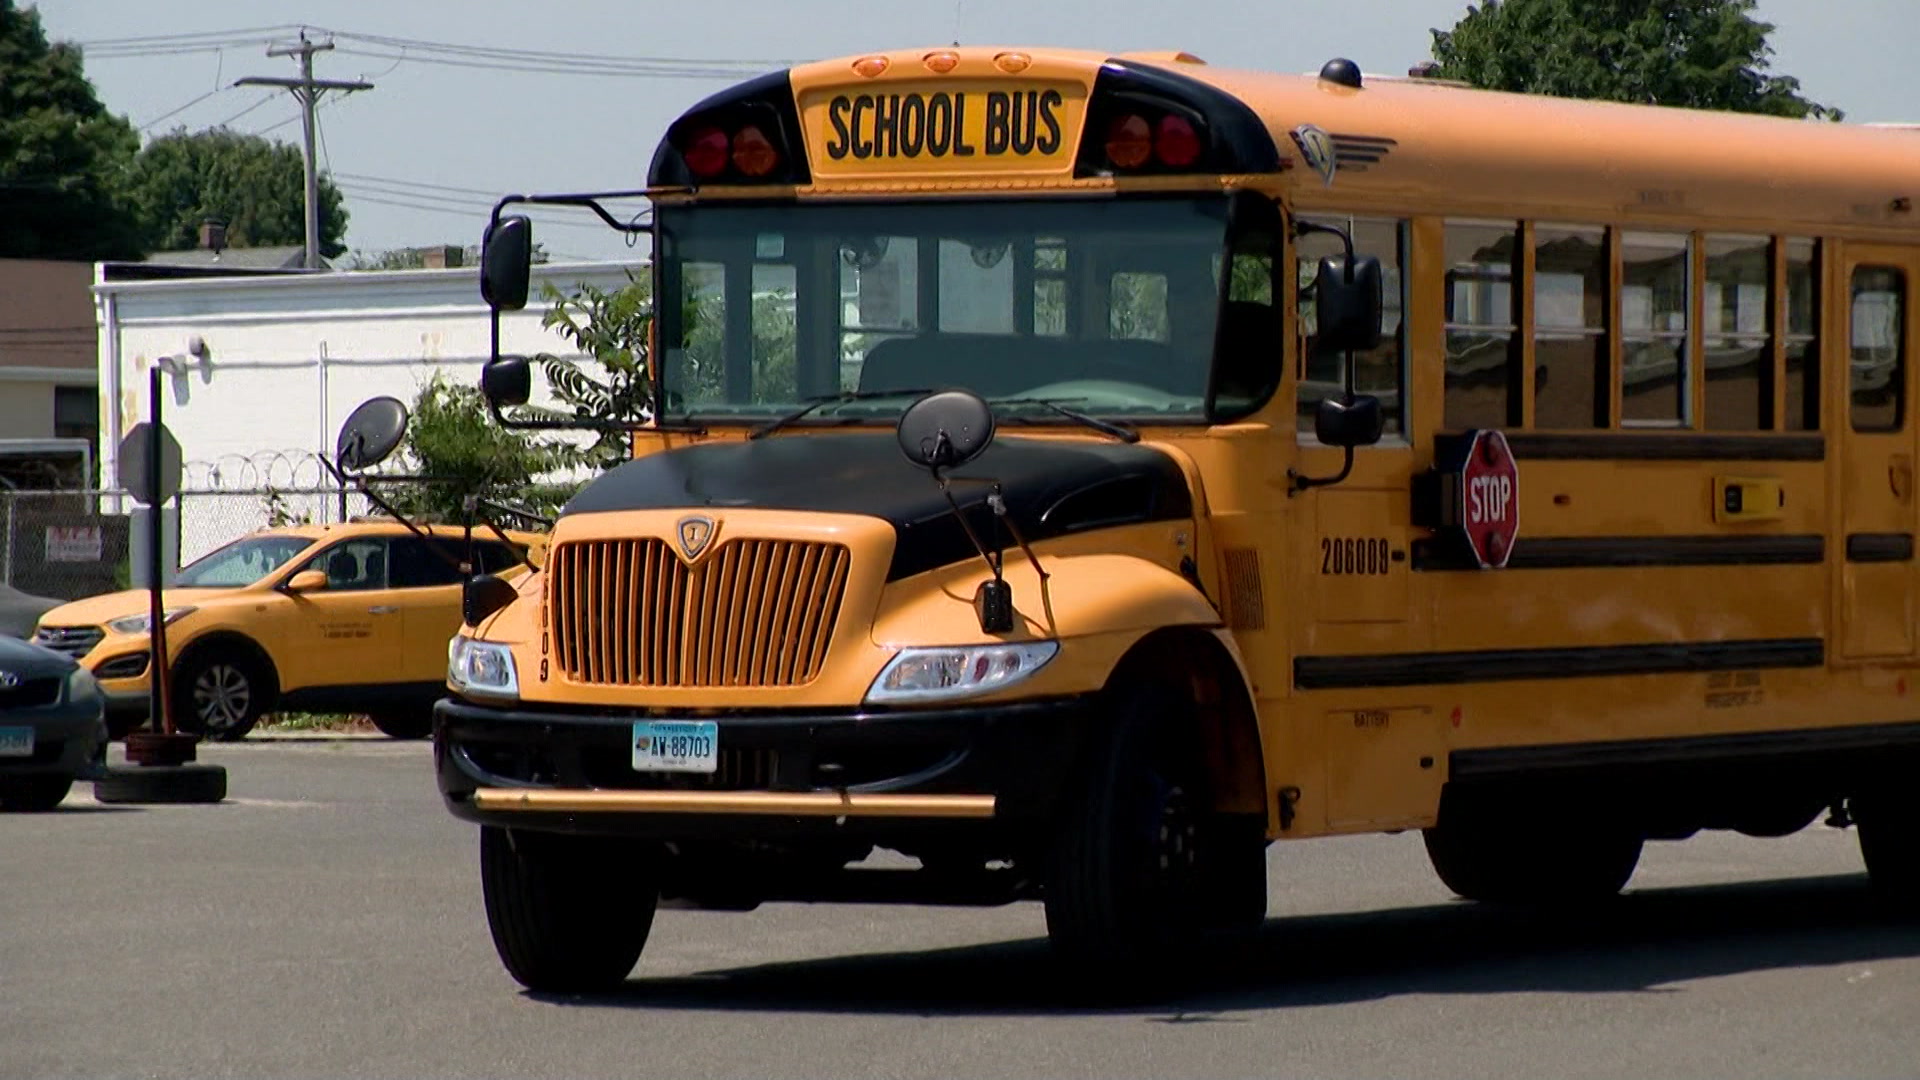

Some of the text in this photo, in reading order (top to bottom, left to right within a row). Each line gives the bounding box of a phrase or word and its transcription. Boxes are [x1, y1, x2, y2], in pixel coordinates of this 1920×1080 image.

[827, 89, 1062, 160] SCHOOL BUS
[1470, 475, 1511, 524] STOP
[1321, 537, 1388, 575] 206009
